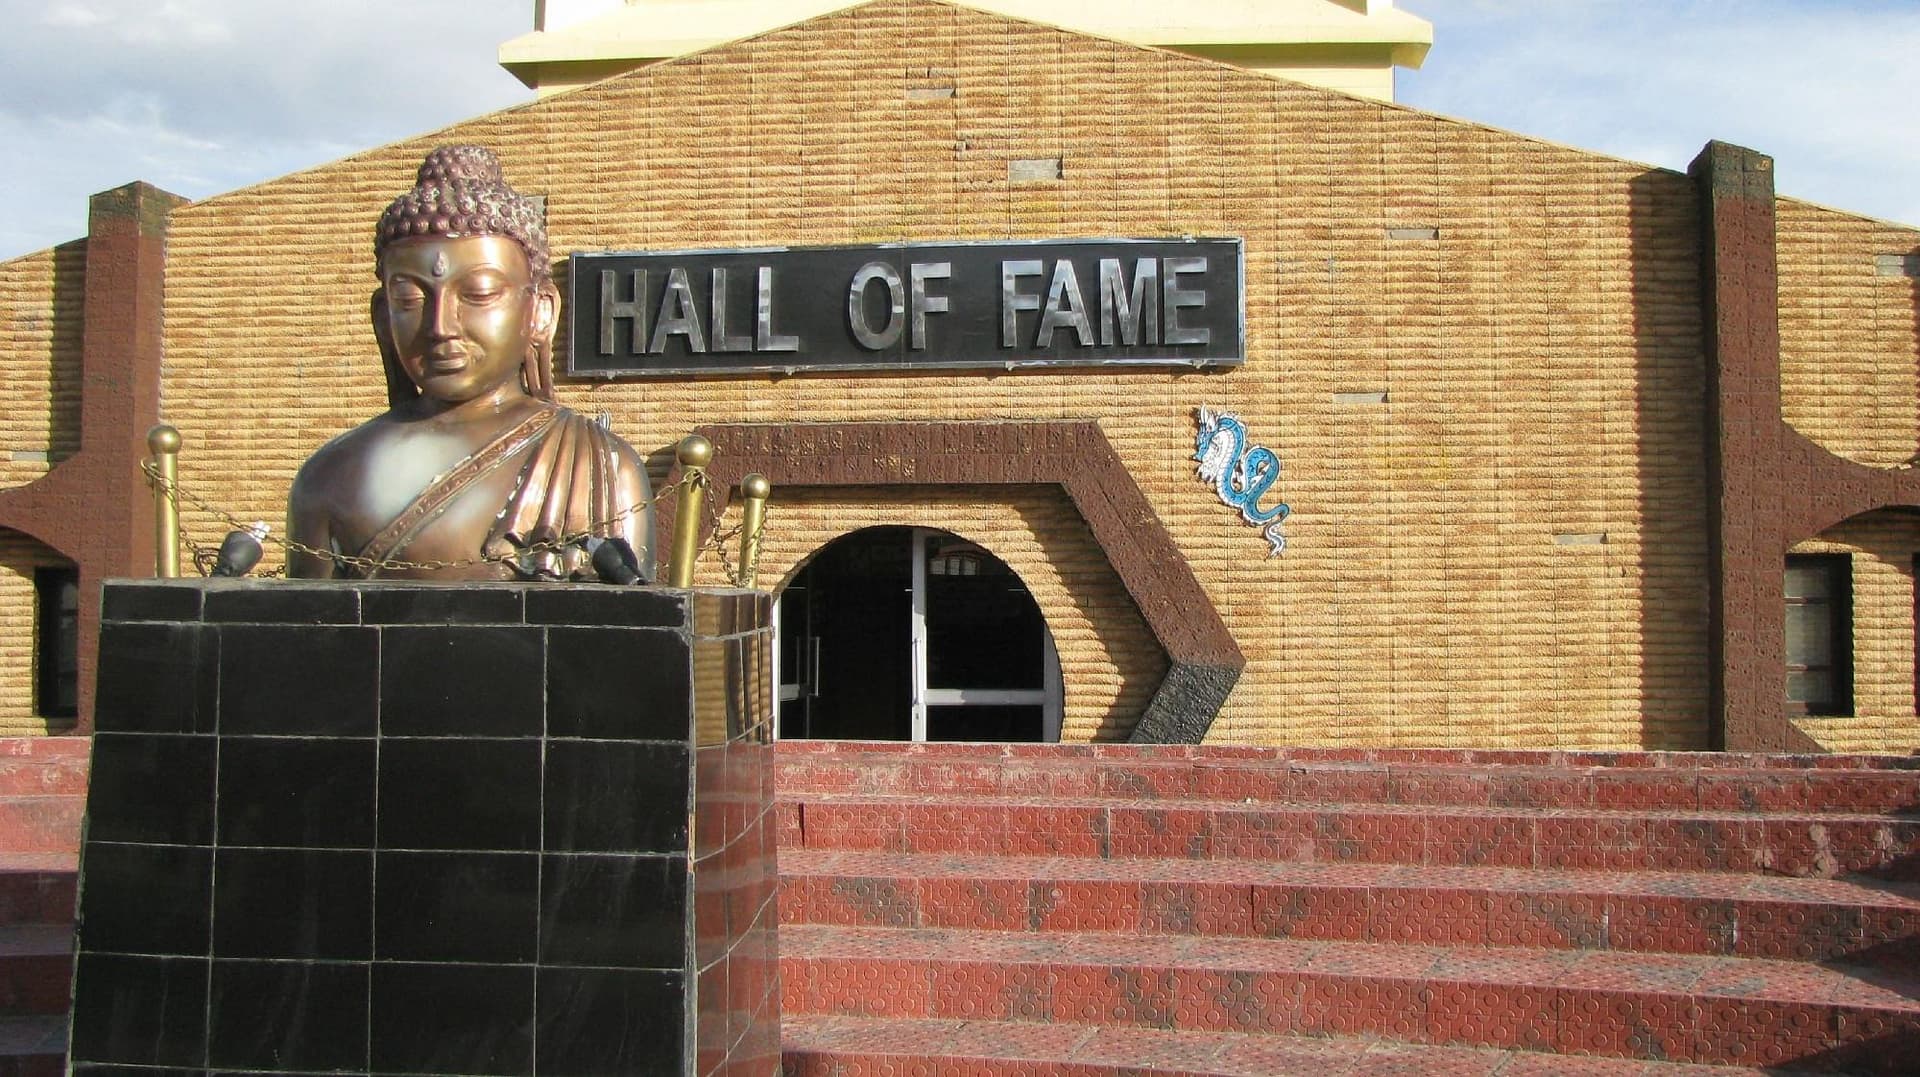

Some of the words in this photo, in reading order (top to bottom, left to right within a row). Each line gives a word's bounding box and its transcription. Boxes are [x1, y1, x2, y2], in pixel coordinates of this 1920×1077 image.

[600, 266, 799, 354] HALL
[849, 261, 951, 350] OF
[1003, 257, 1210, 348] FAME
